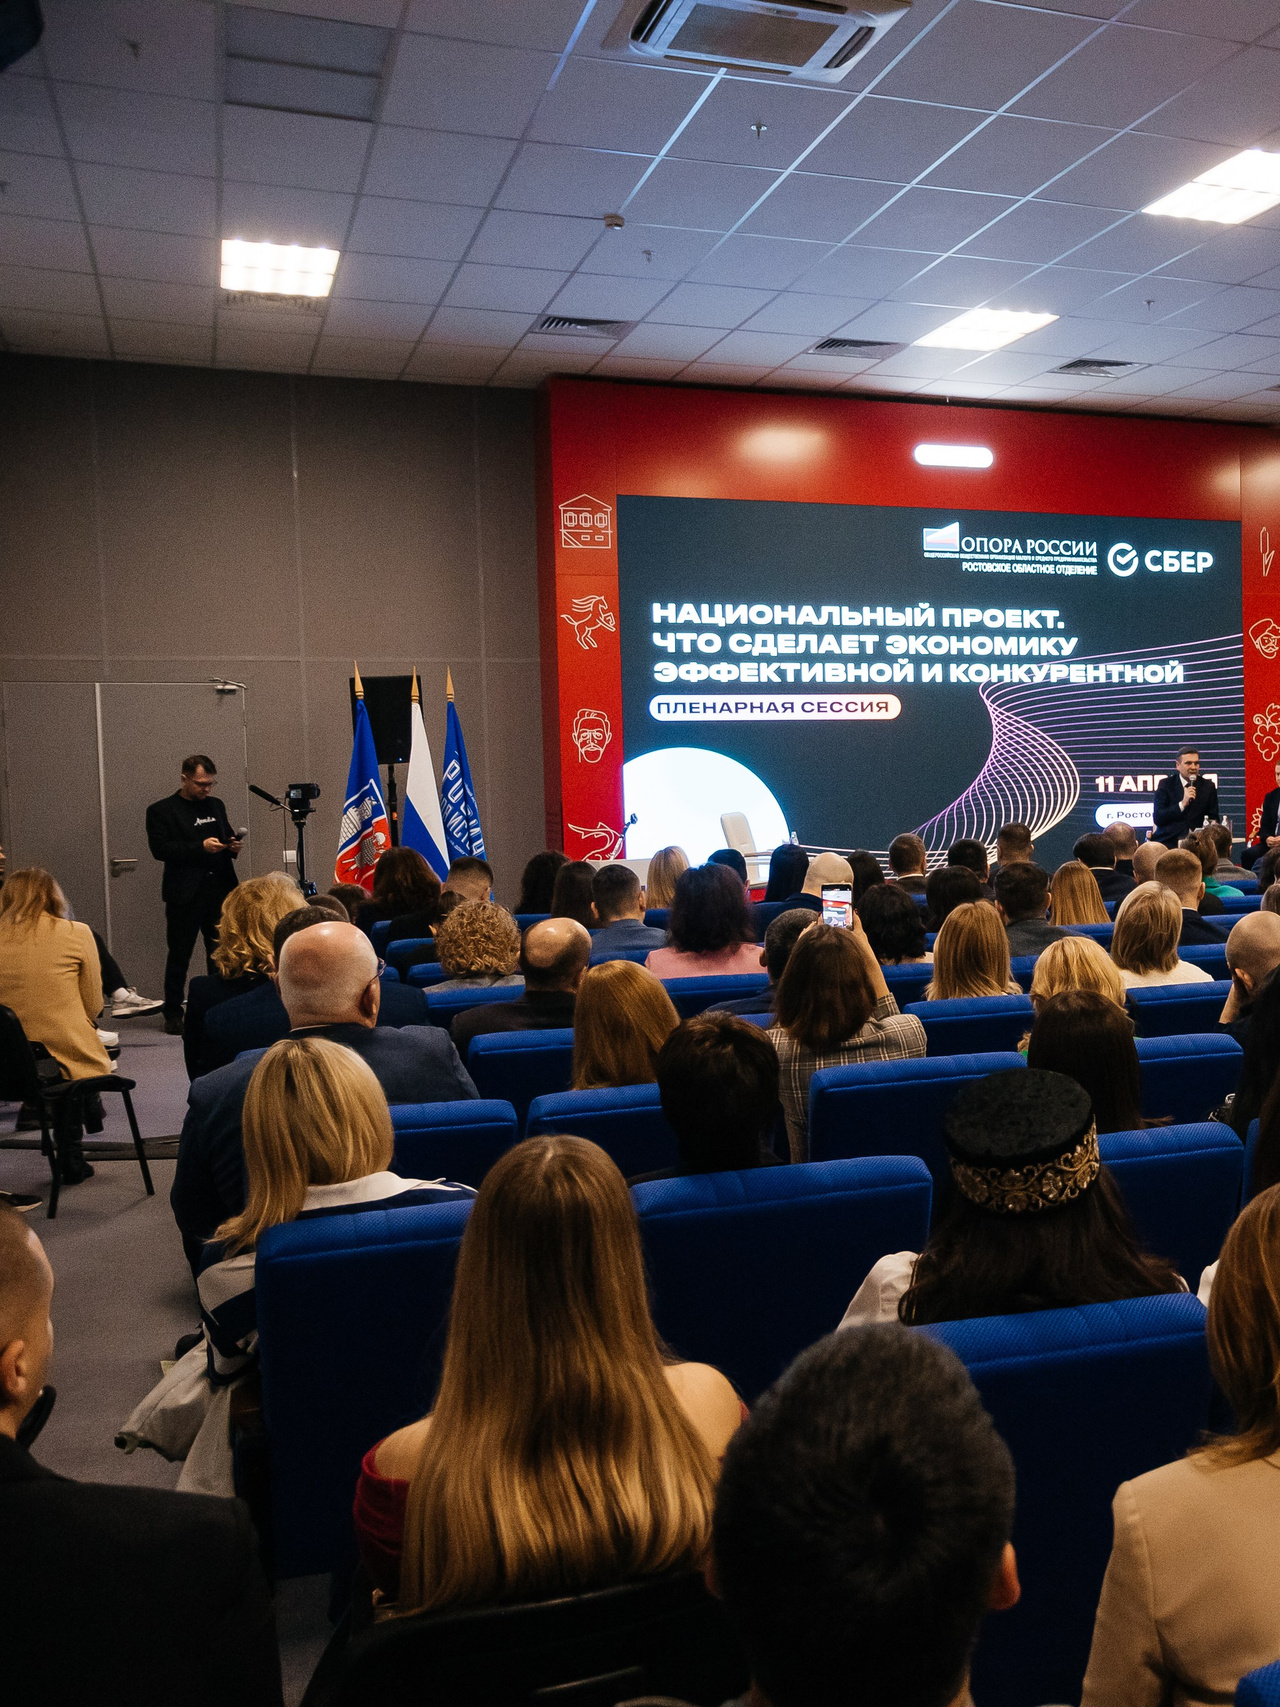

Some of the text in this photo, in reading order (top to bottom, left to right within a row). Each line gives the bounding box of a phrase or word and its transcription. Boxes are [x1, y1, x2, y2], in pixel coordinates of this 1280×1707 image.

[961, 537, 1097, 556] ОПОРА РОССИИ
[962, 561, 1098, 576] РОСТОВСКОЕ ОБЛАСТНОЕ ОТДЕЛЕНИЕ
[1144, 549, 1214, 573] СБЕР
[652, 602, 1065, 629] НАЦИОНАЛЬНЫЙ ПРОЕКТ.
[652, 632, 1079, 657] ЧТО СДЕЛАЕТ ЭКОНОМИКУ
[653, 658, 1185, 684] ЭФФЕКТИВНОЙ И КОНКУРЕНТНОЙ
[657, 701, 889, 714] ПЛЕНАРНАЯ СЕССИЯ
[1095, 775, 1115, 793] 11
[1116, 811, 1154, 819] Росто
